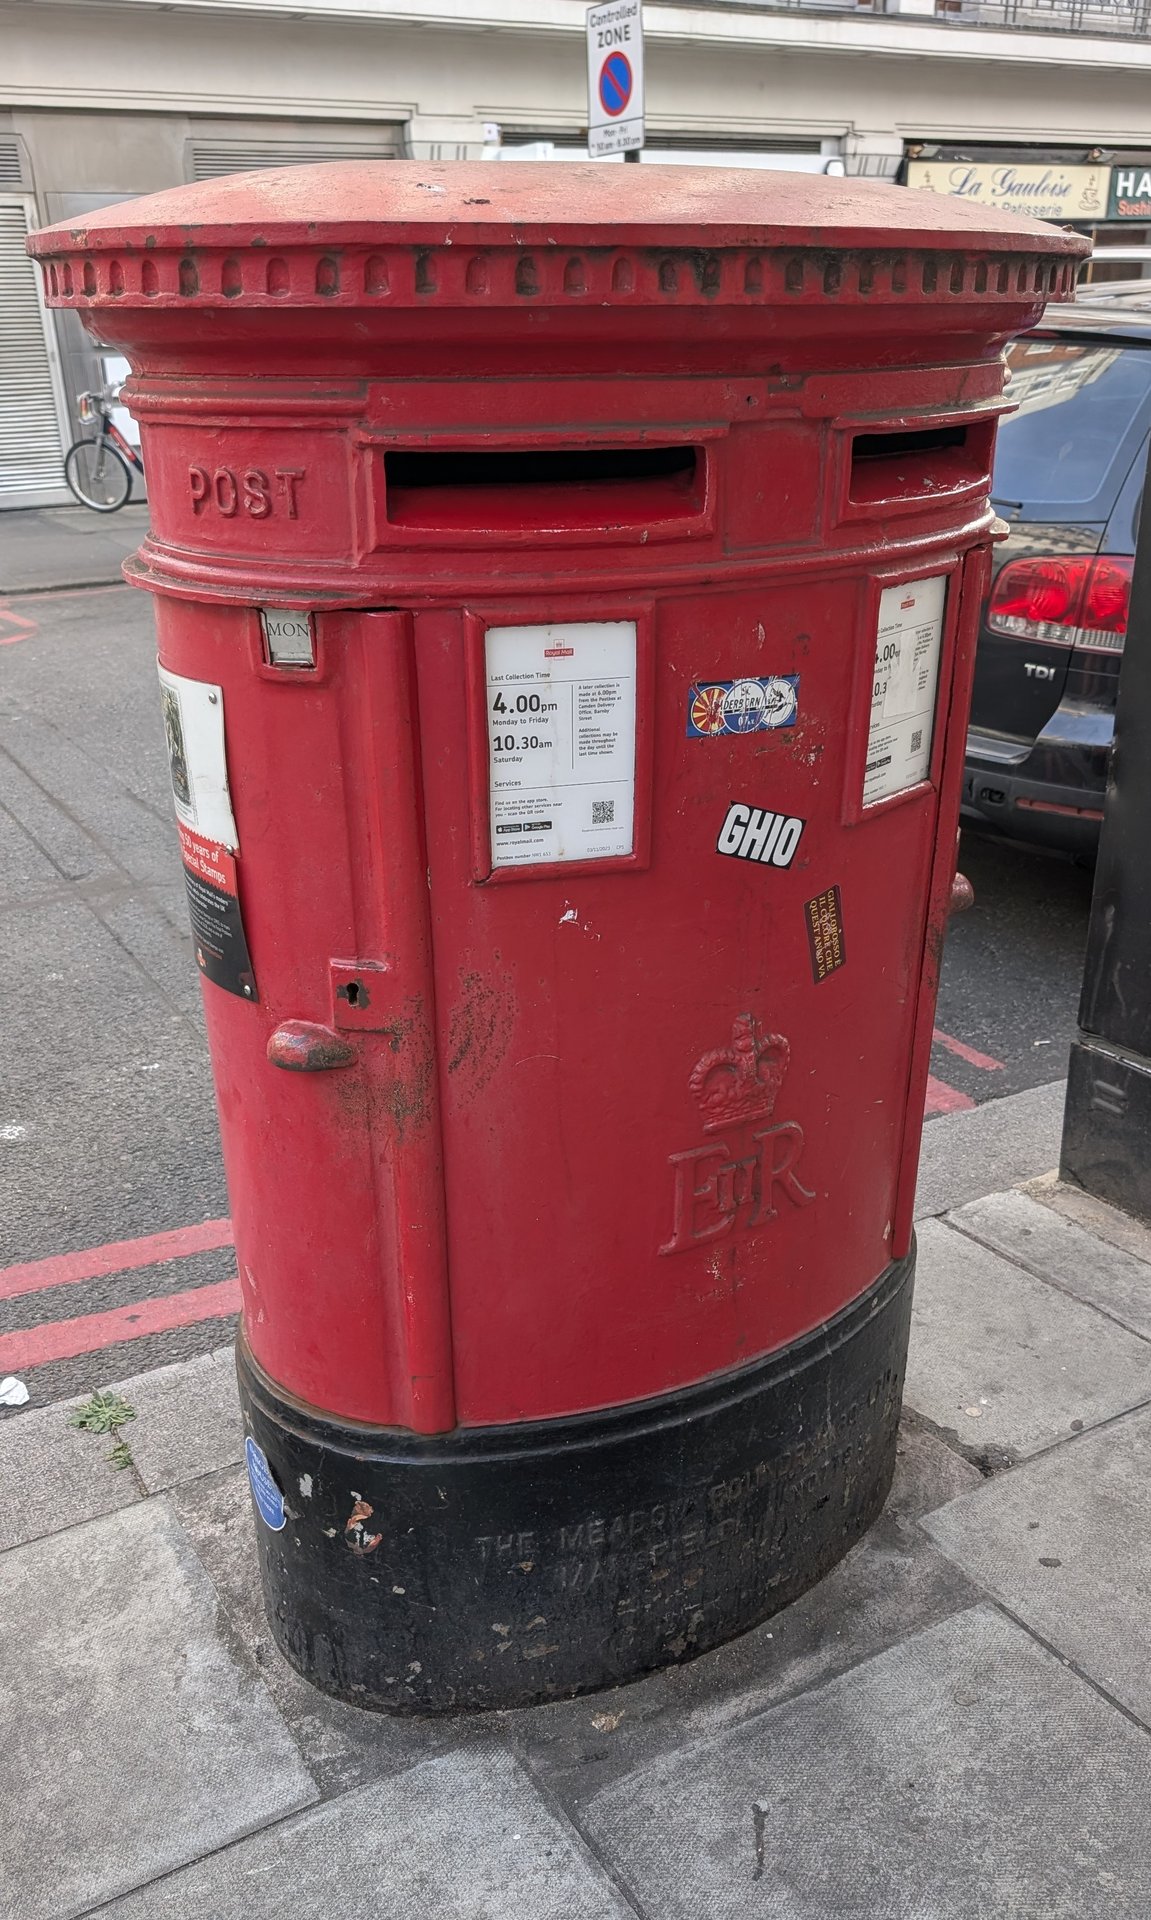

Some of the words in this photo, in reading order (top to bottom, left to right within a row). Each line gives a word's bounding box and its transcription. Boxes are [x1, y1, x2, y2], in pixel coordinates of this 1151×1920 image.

[590, 2, 637, 28] Controlled
[597, 24, 631, 49] ZONE
[949, 167, 982, 196] La
[991, 168, 1073, 199] Gauloise
[1116, 172, 1151, 197] HA
[1003, 202, 1063, 217] Patisserie
[188, 464, 306, 520] POST
[267, 622, 311, 638] MON
[505, 673, 535, 681] Collection
[536, 671, 551, 679] Time
[1024, 663, 1056, 681] TDI
[492, 691, 558, 715] 4.00pm
[493, 719, 518, 727] Monday
[529, 717, 550, 725] Friday
[493, 734, 553, 752] 10.30am
[591, 737, 617, 745] throughout
[494, 755, 523, 764] Saturday
[494, 780, 522, 788] Services
[496, 837, 544, 847] www.royalmail.com
[718, 803, 803, 867] GHIO
[185, 834, 192, 848] 50
[192, 842, 210, 859] years
[211, 851, 219, 863] of
[183, 848, 200, 870] pecial
[200, 859, 226, 885] Stamps
[819, 896, 826, 907] IL
[820, 908, 831, 948] COLORE
[828, 889, 840, 958] GIALLOROSSO
[835, 959, 842, 967] E
[818, 964, 826, 978] VA
[474, 1531, 536, 1562] THE
